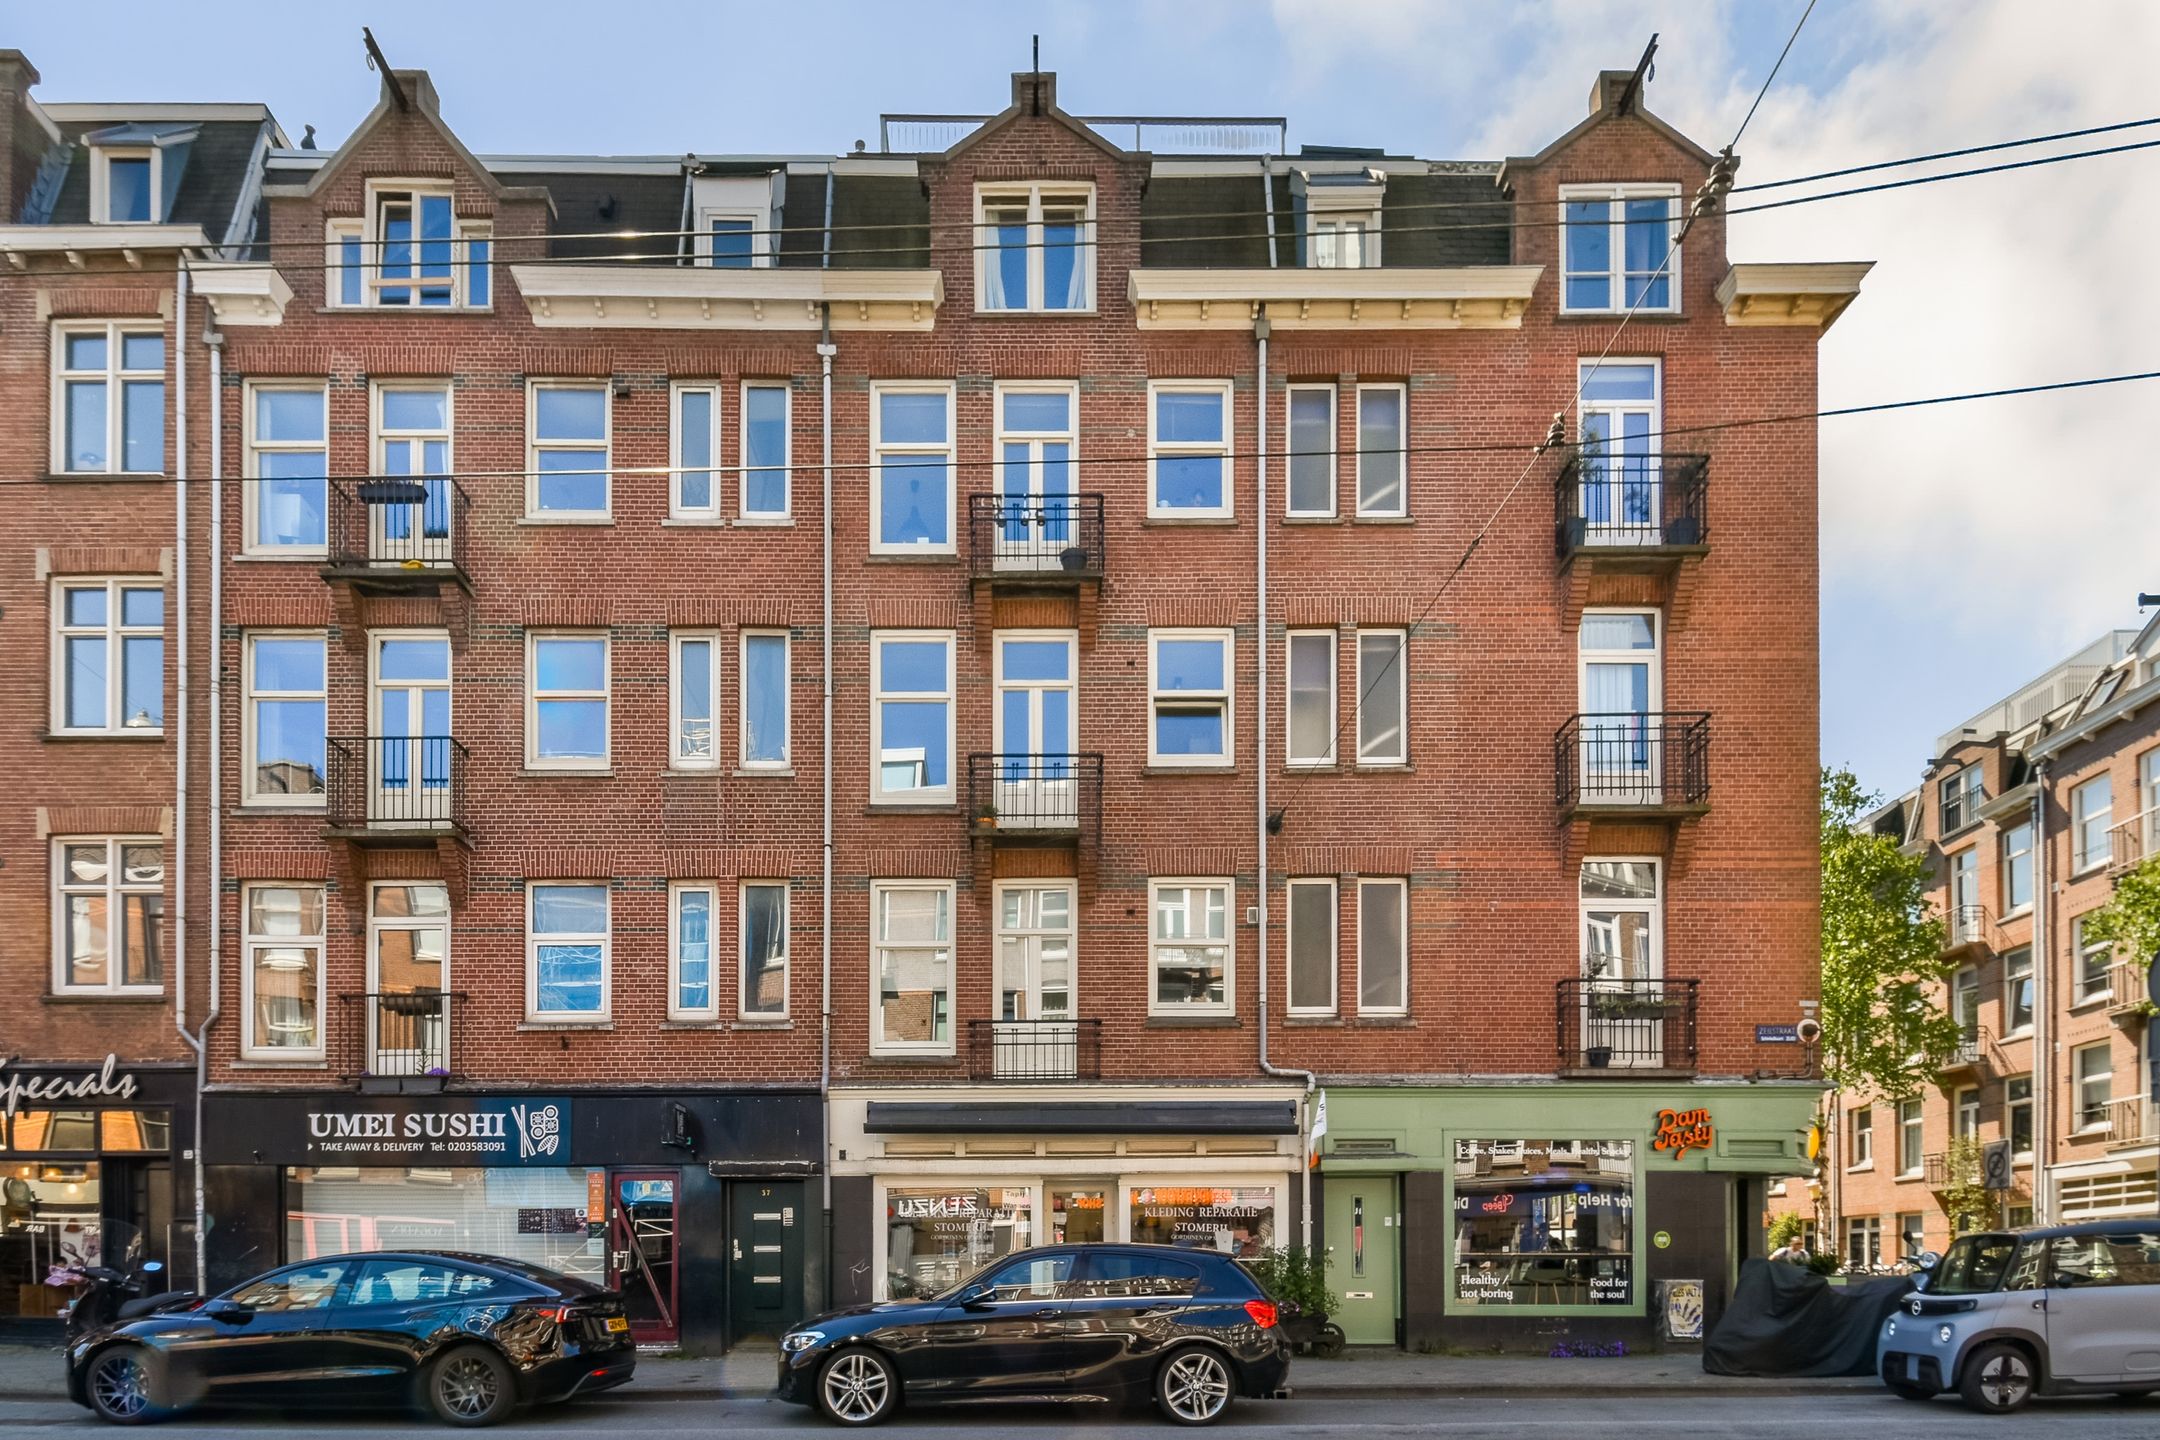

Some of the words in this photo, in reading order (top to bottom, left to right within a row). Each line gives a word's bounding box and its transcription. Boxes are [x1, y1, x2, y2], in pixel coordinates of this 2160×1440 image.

[307, 1113, 396, 1138] UMEI
[403, 1113, 506, 1138] SUSHI
[320, 1142, 343, 1151] TAKE
[344, 1142, 372, 1151] AWAY
[373, 1142, 381, 1151] &
[383, 1142, 424, 1151] DELIVERY
[430, 1142, 446, 1151] Tel:
[447, 1142, 506, 1152] 0203583091
[1144, 1206, 1194, 1218] KLEDING
[1199, 1207, 1258, 1218] REPARATIE
[1461, 1274, 1501, 1287] Healthy
[1590, 1277, 1614, 1288] Food
[1615, 1277, 1629, 1288] for
[1460, 1290, 1479, 1298] not
[1480, 1288, 1514, 1300] boring
[1590, 1289, 1606, 1299] the
[1606, 1289, 1626, 1299] soul
